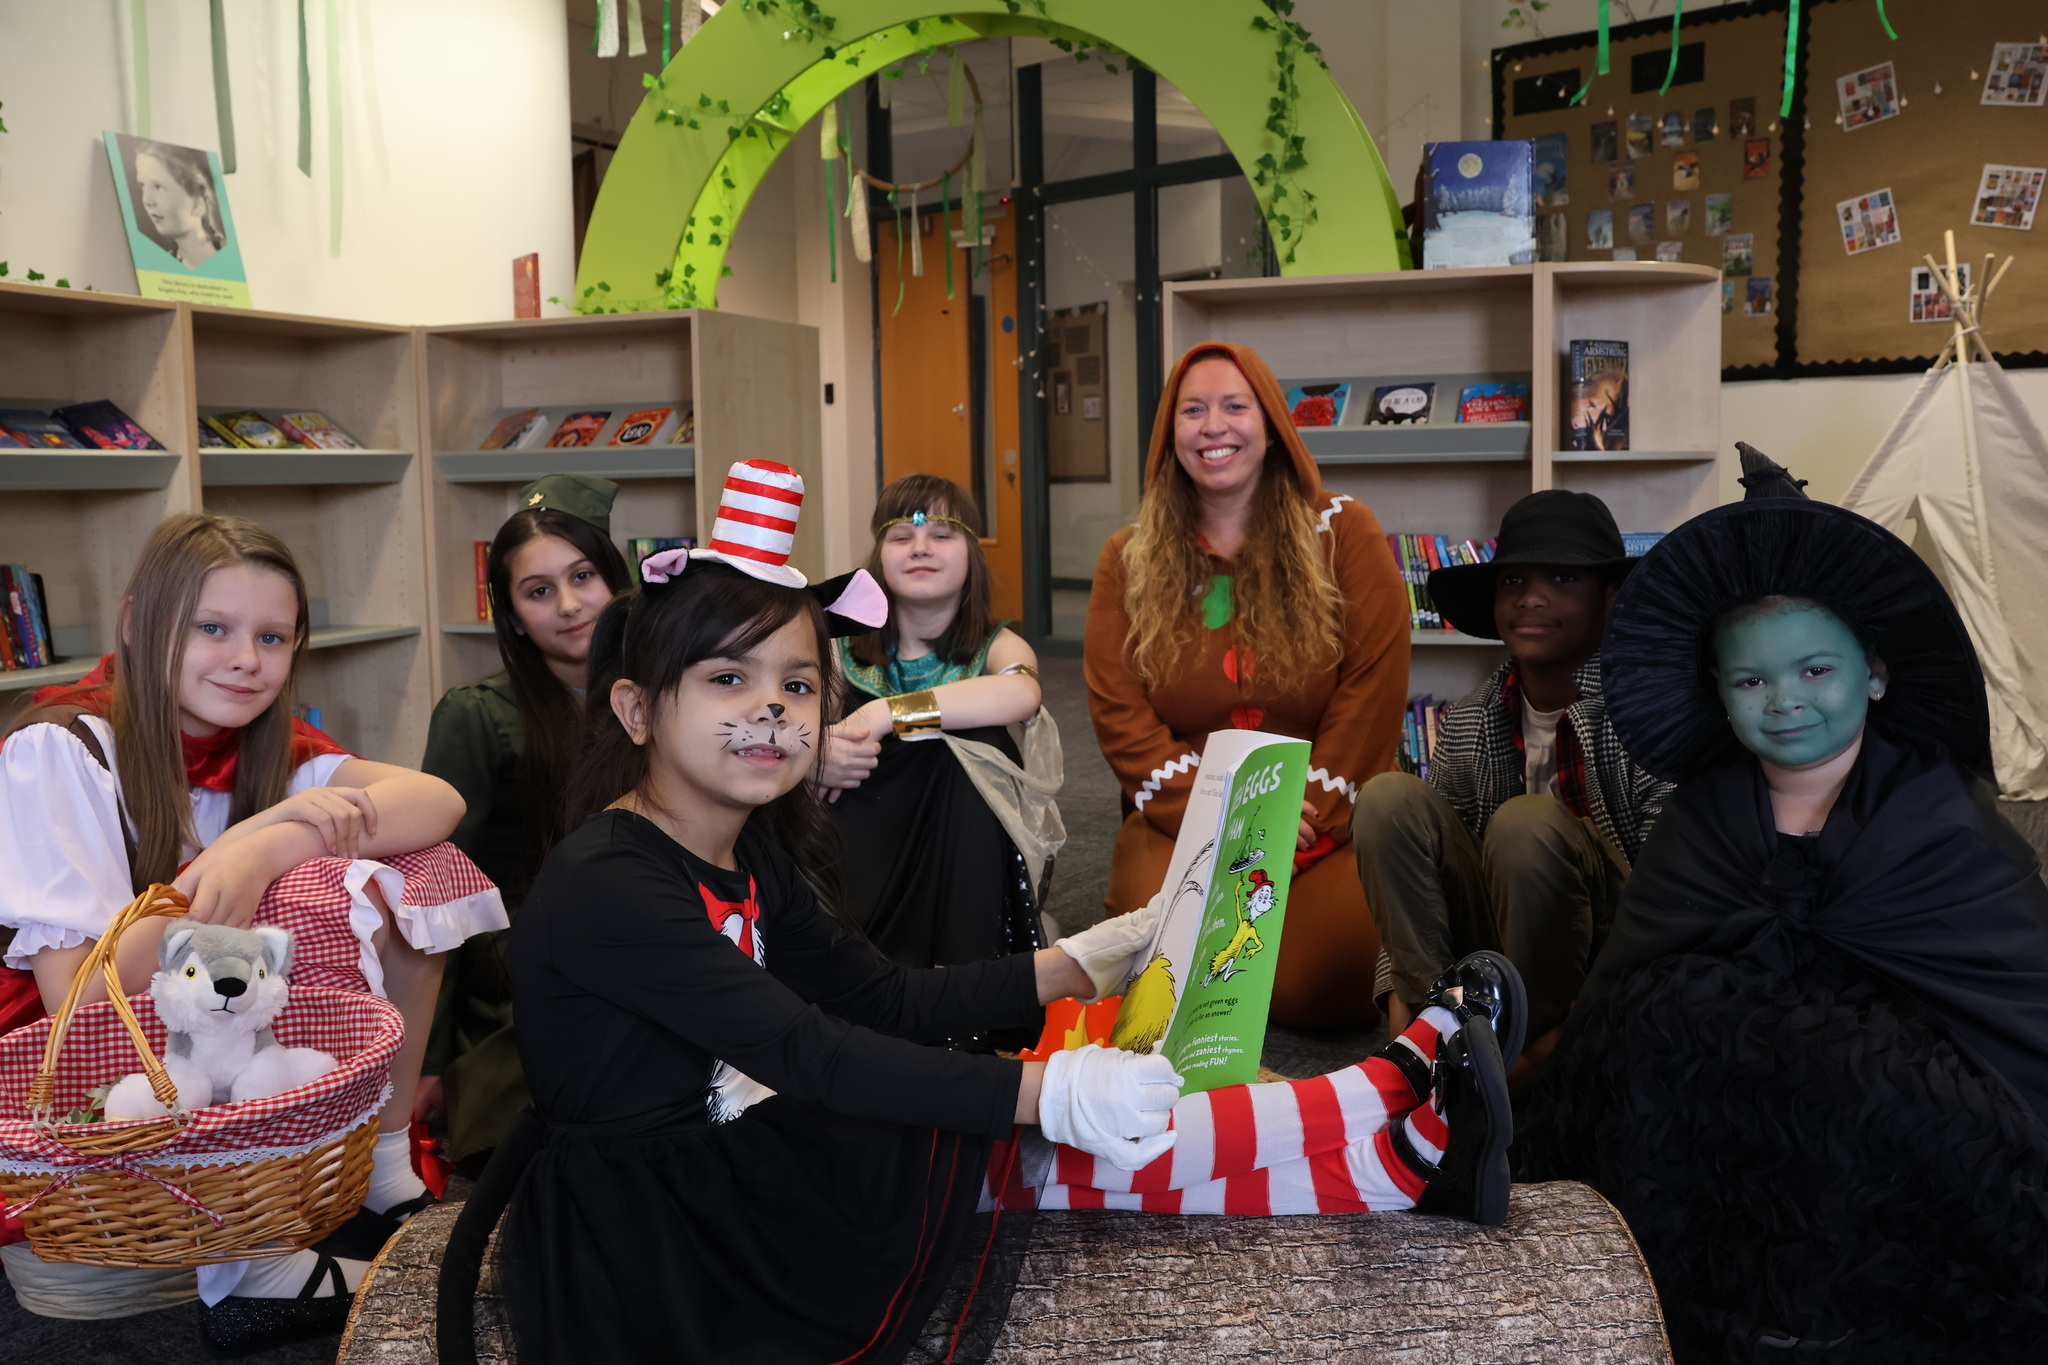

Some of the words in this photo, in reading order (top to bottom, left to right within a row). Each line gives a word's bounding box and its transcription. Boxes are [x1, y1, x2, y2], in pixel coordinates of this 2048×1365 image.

[1583, 347, 1627, 357] ARMSTRONG
[1242, 762, 1284, 805] EGGS
[1209, 999, 1223, 1008] green
[1224, 998, 1238, 1006] eggs
[1211, 1008, 1232, 1017] answer!
[1192, 1033, 1218, 1046] funniest
[1195, 1045, 1222, 1056] zaniest
[1222, 1046, 1245, 1055] rhymes.
[1192, 1060, 1209, 1069] reading
[1209, 1056, 1228, 1066] FUN!
